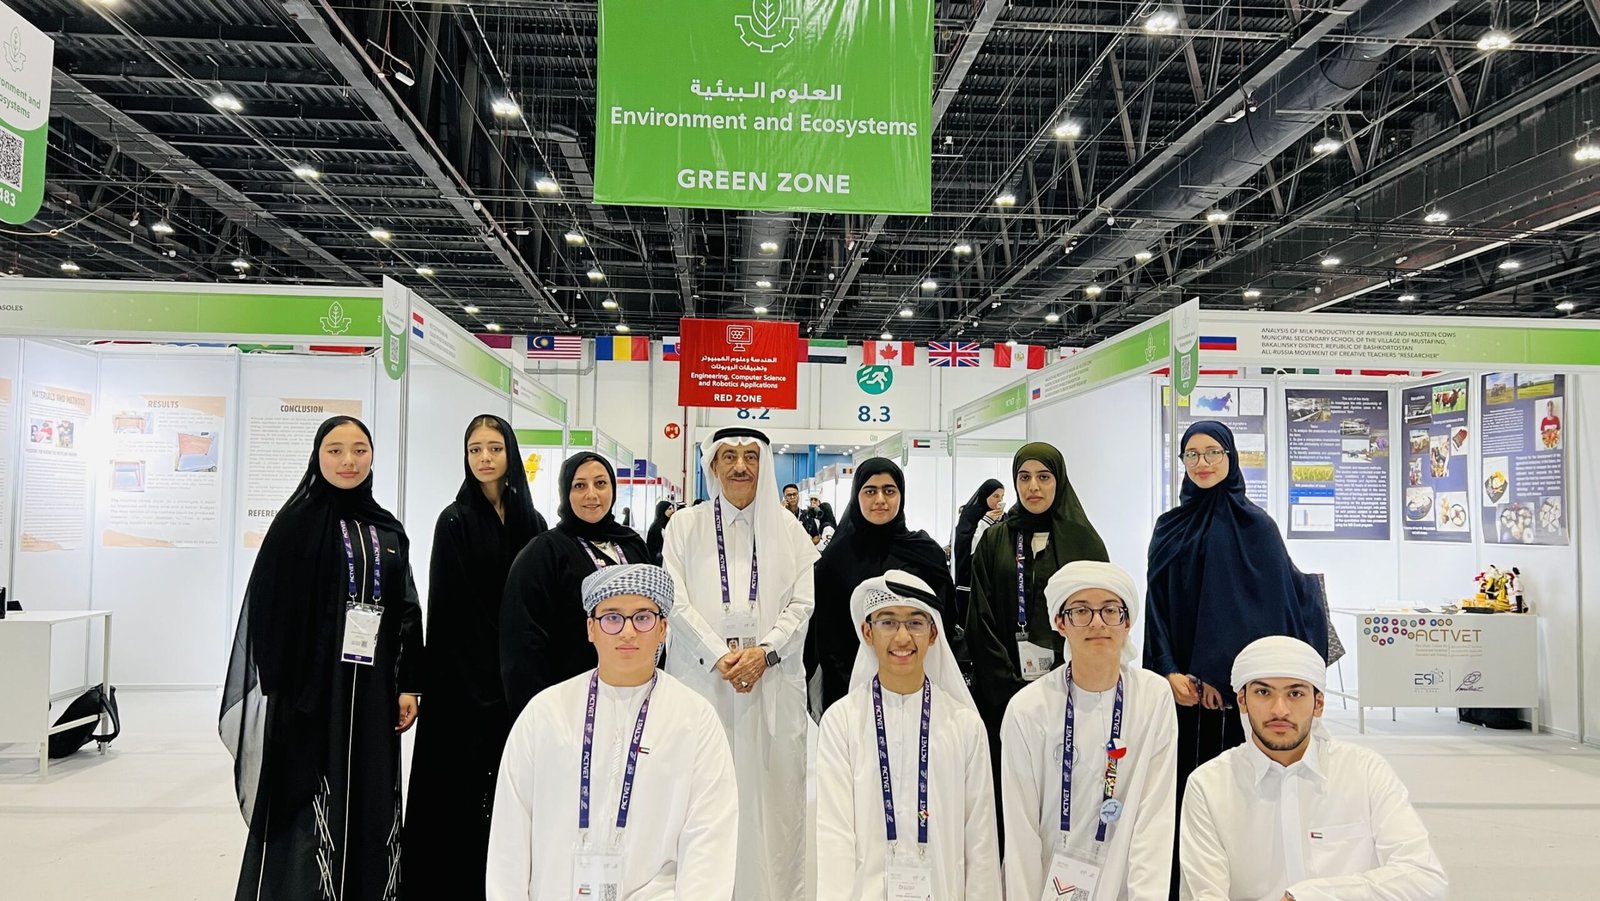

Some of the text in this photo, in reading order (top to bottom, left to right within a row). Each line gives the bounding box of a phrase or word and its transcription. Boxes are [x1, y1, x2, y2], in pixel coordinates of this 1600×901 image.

[0, 77, 40, 110] onment and
[770, 83, 841, 103] العلوم
[611, 106, 917, 138] Environment and Ecosystems
[678, 168, 850, 194] GREEN ZONE
[737, 406, 890, 422] 8.2 8.3
[1416, 629, 1482, 642] ACTVET
[1415, 674, 1434, 685] ESI
[633, 719, 644, 744] ACTVET
[621, 782, 630, 810] ACTVET
